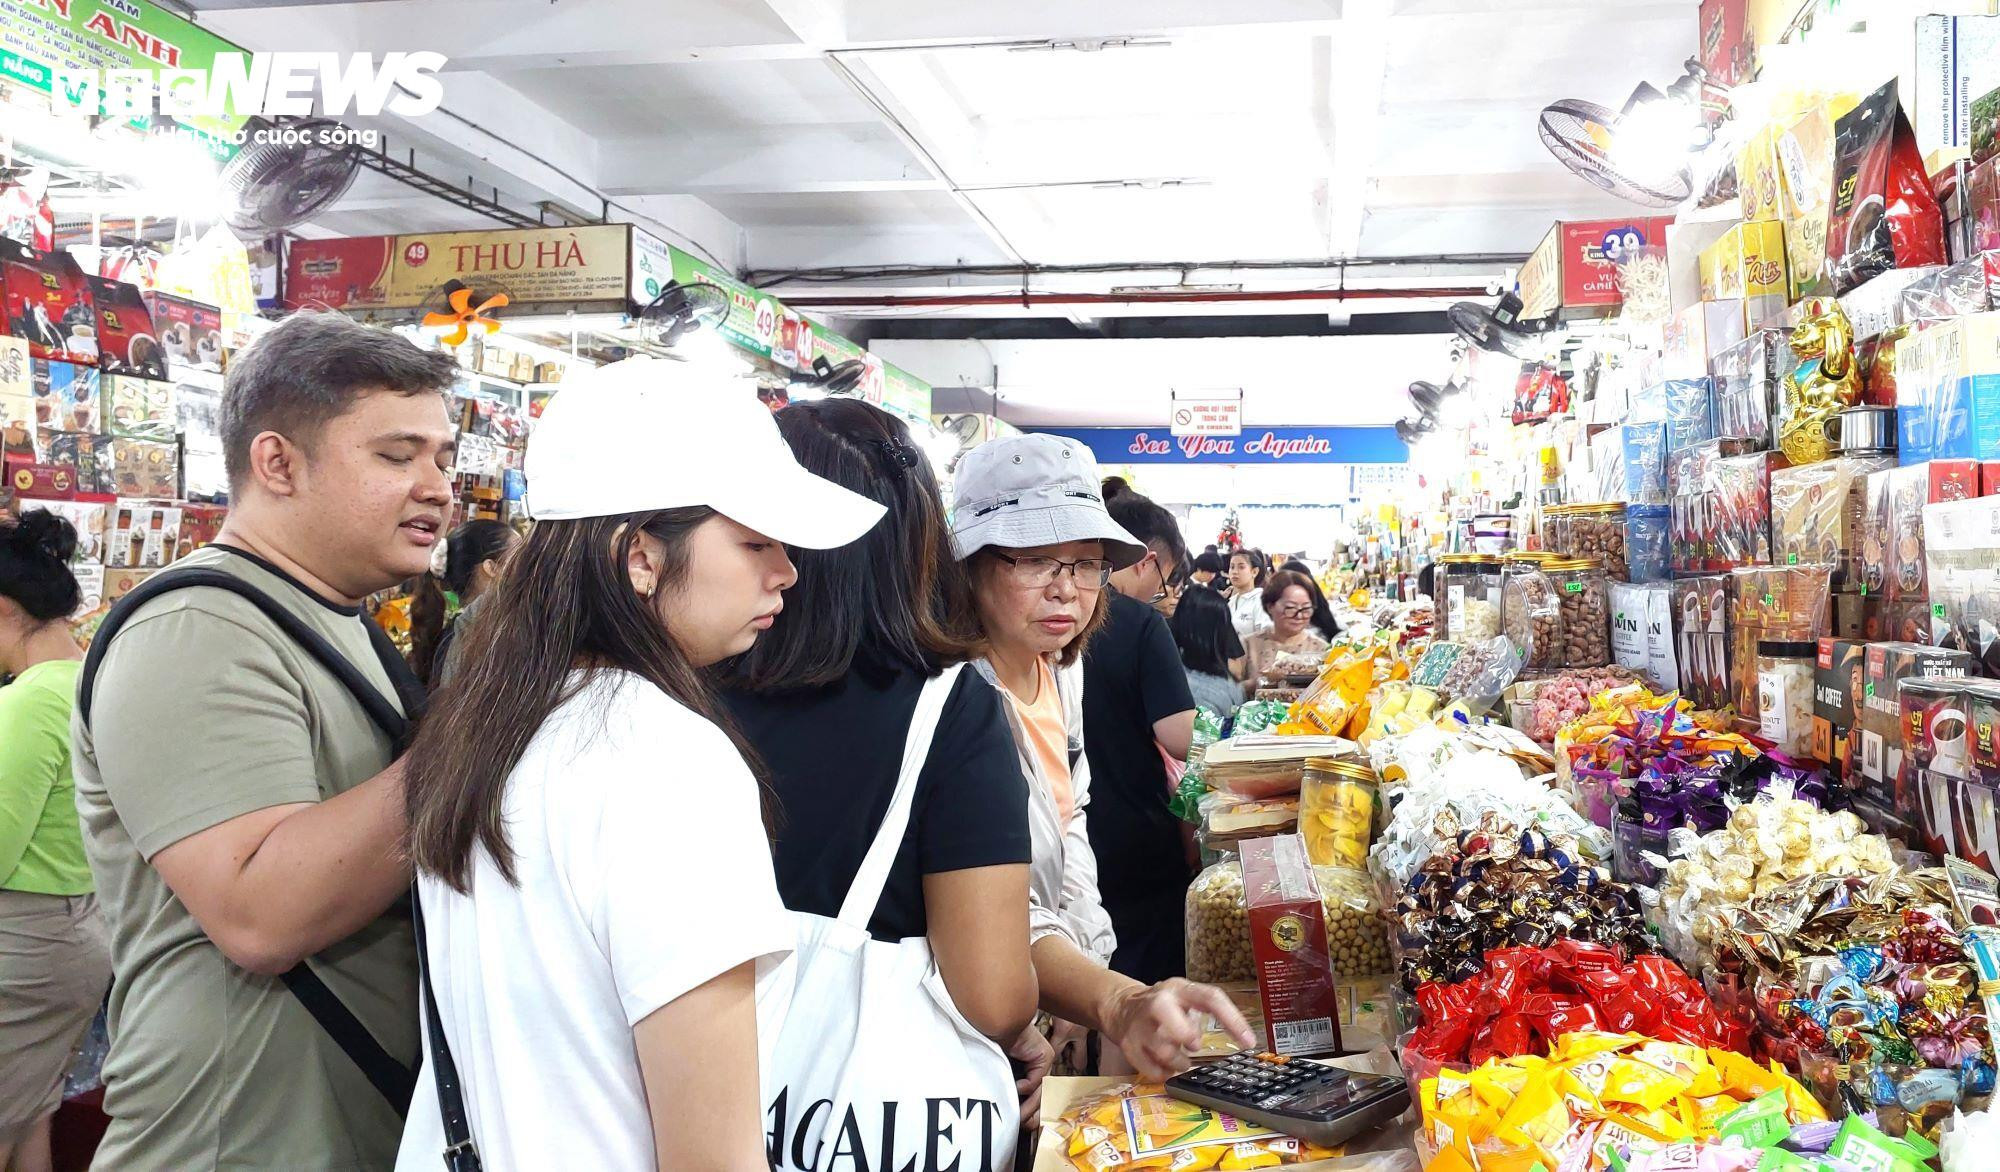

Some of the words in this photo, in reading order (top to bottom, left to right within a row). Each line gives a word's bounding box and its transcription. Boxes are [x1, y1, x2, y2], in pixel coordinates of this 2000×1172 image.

[86, 12, 180, 68] ANH
[1941, 35, 1949, 52] film
[1941, 53, 1951, 96] protective
[1941, 99, 1949, 111] the
[1961, 76, 1970, 118] installing
[1961, 118, 1969, 138] after
[408, 244, 426, 260] 49
[450, 243, 526, 273] THU
[536, 232, 588, 269] HÀ
[1605, 232, 1641, 259] 39
[757, 310, 772, 337] 49
[1129, 432, 1171, 454] See
[1177, 434, 1235, 459] You
[1244, 432, 1332, 459] Again
[1923, 664, 1943, 680] VIỆT
[1945, 667, 1966, 680] NAM
[1825, 686, 1843, 709] COFFEE
[1884, 700, 1900, 717] COFFEE
